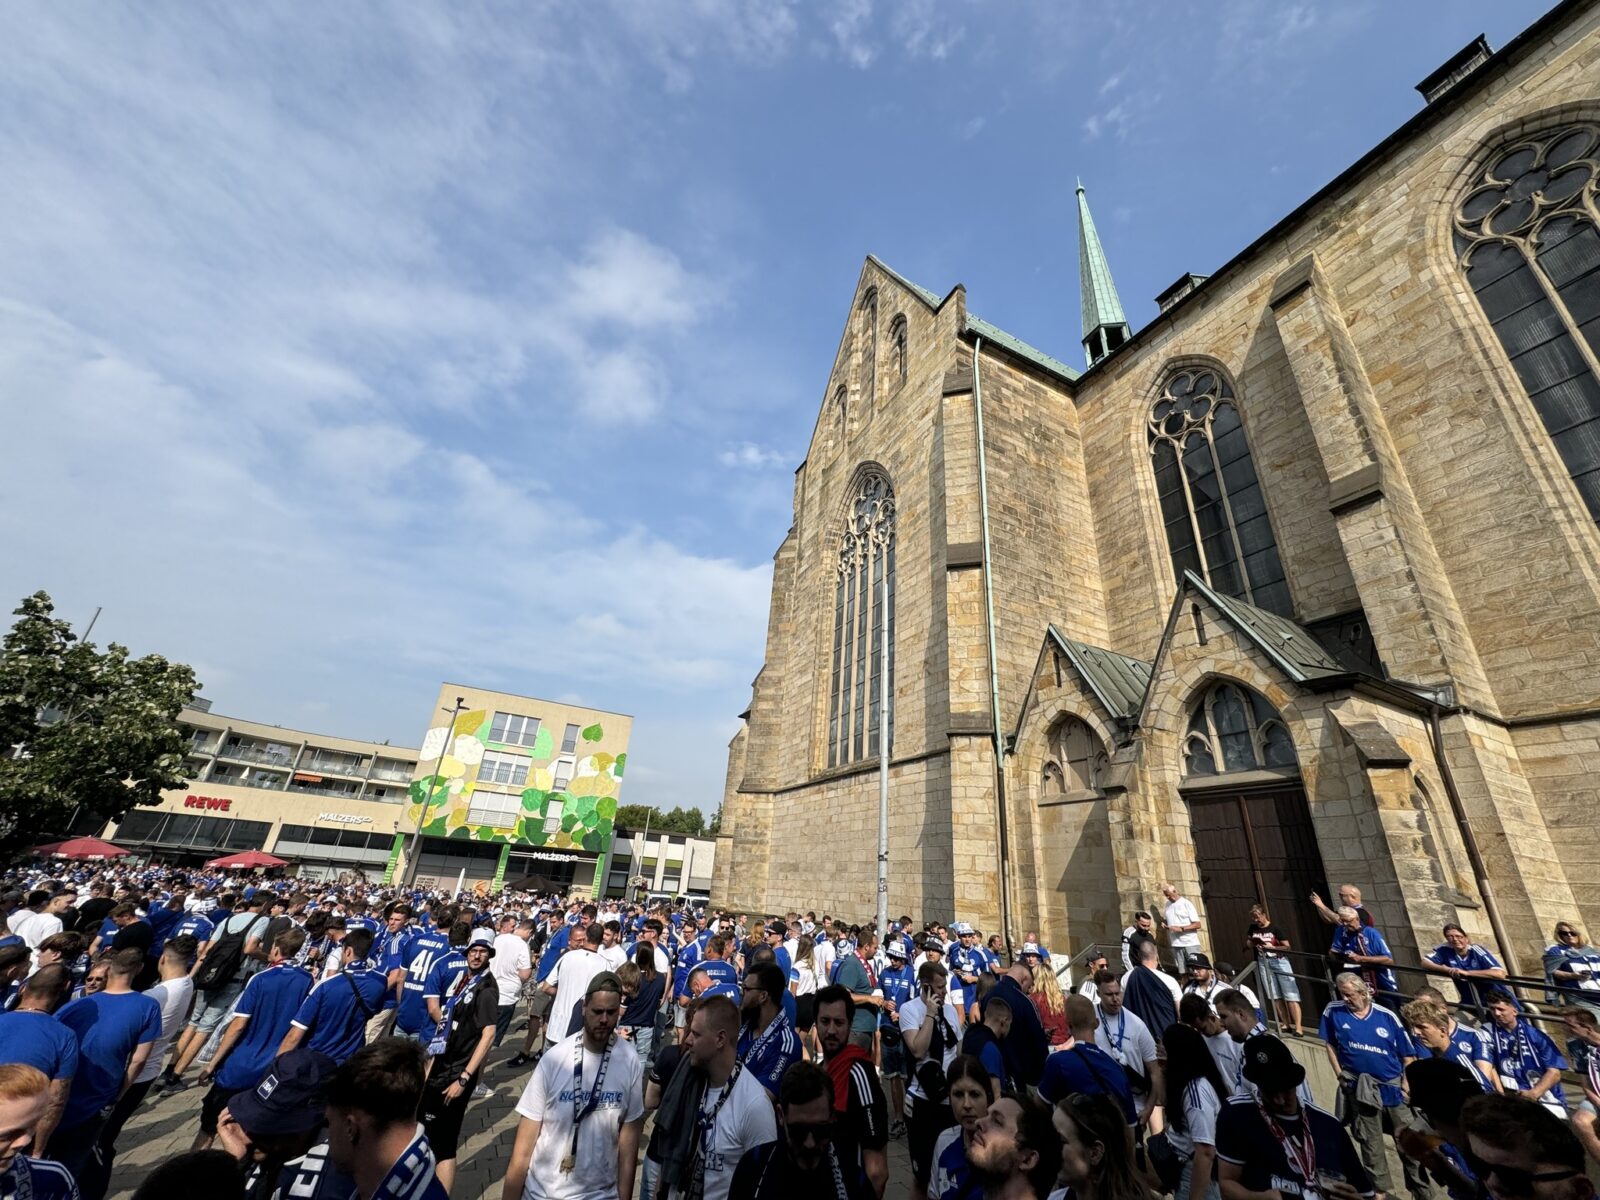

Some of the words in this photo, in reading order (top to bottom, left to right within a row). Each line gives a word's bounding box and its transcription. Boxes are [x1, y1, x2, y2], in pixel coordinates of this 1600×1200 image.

[184, 795, 232, 811] REWE
[319, 812, 363, 824] MALZERS
[533, 852, 570, 862] MALZERS
[409, 949, 434, 982] 41
